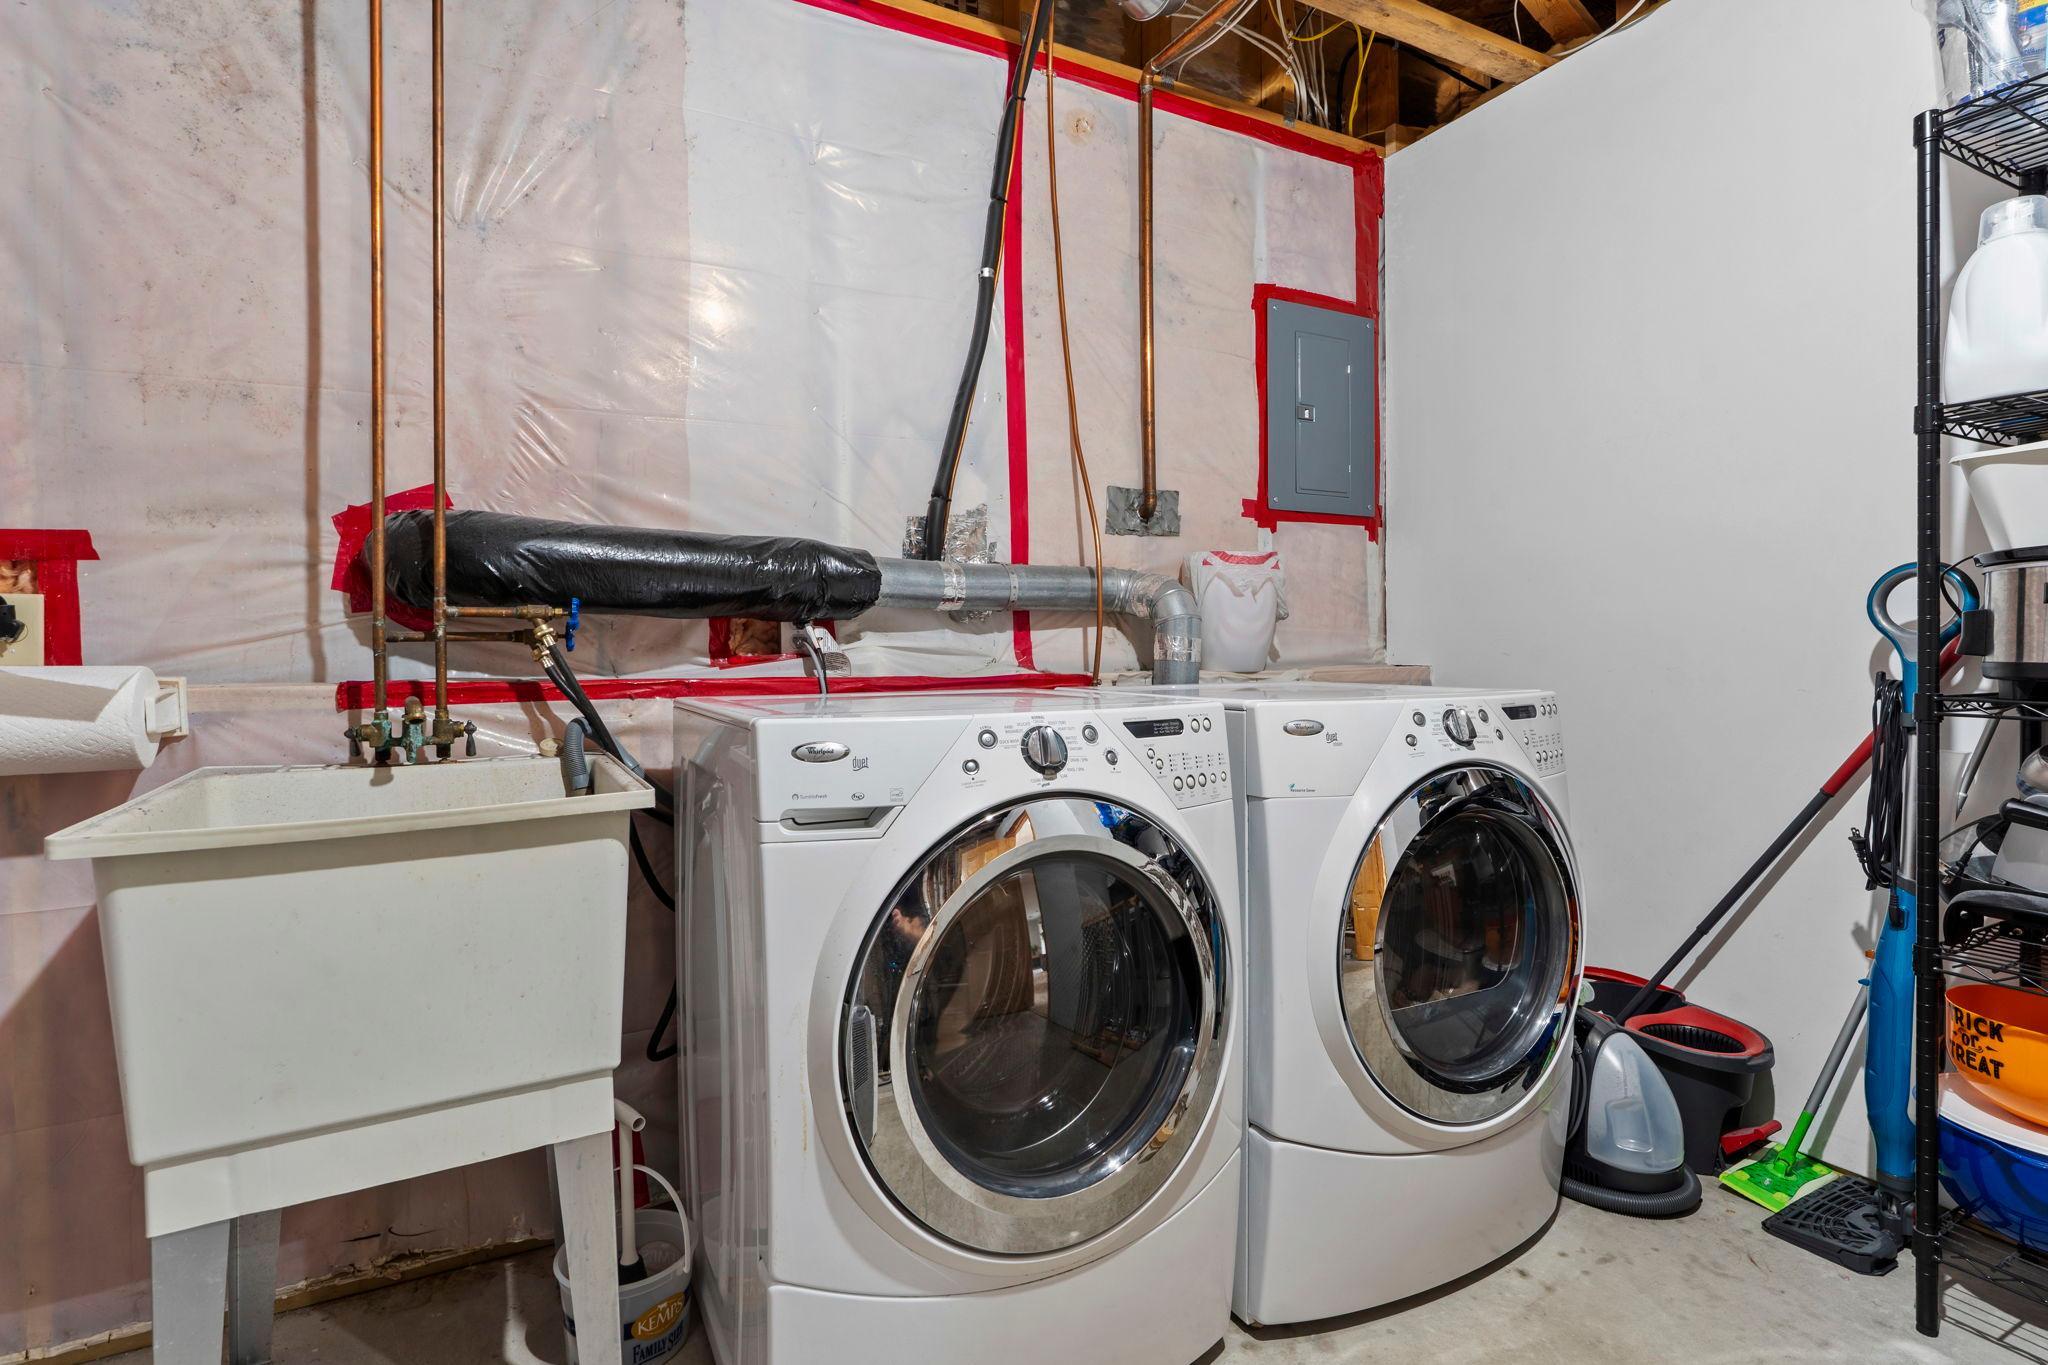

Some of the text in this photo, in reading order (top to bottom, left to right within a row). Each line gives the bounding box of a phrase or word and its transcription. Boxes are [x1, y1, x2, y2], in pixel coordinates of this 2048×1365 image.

[805, 746, 835, 756] Whirlpool
[852, 756, 869, 770] duet
[638, 1300, 683, 1335] KEMPS
[633, 1336, 668, 1364] FAMILY
